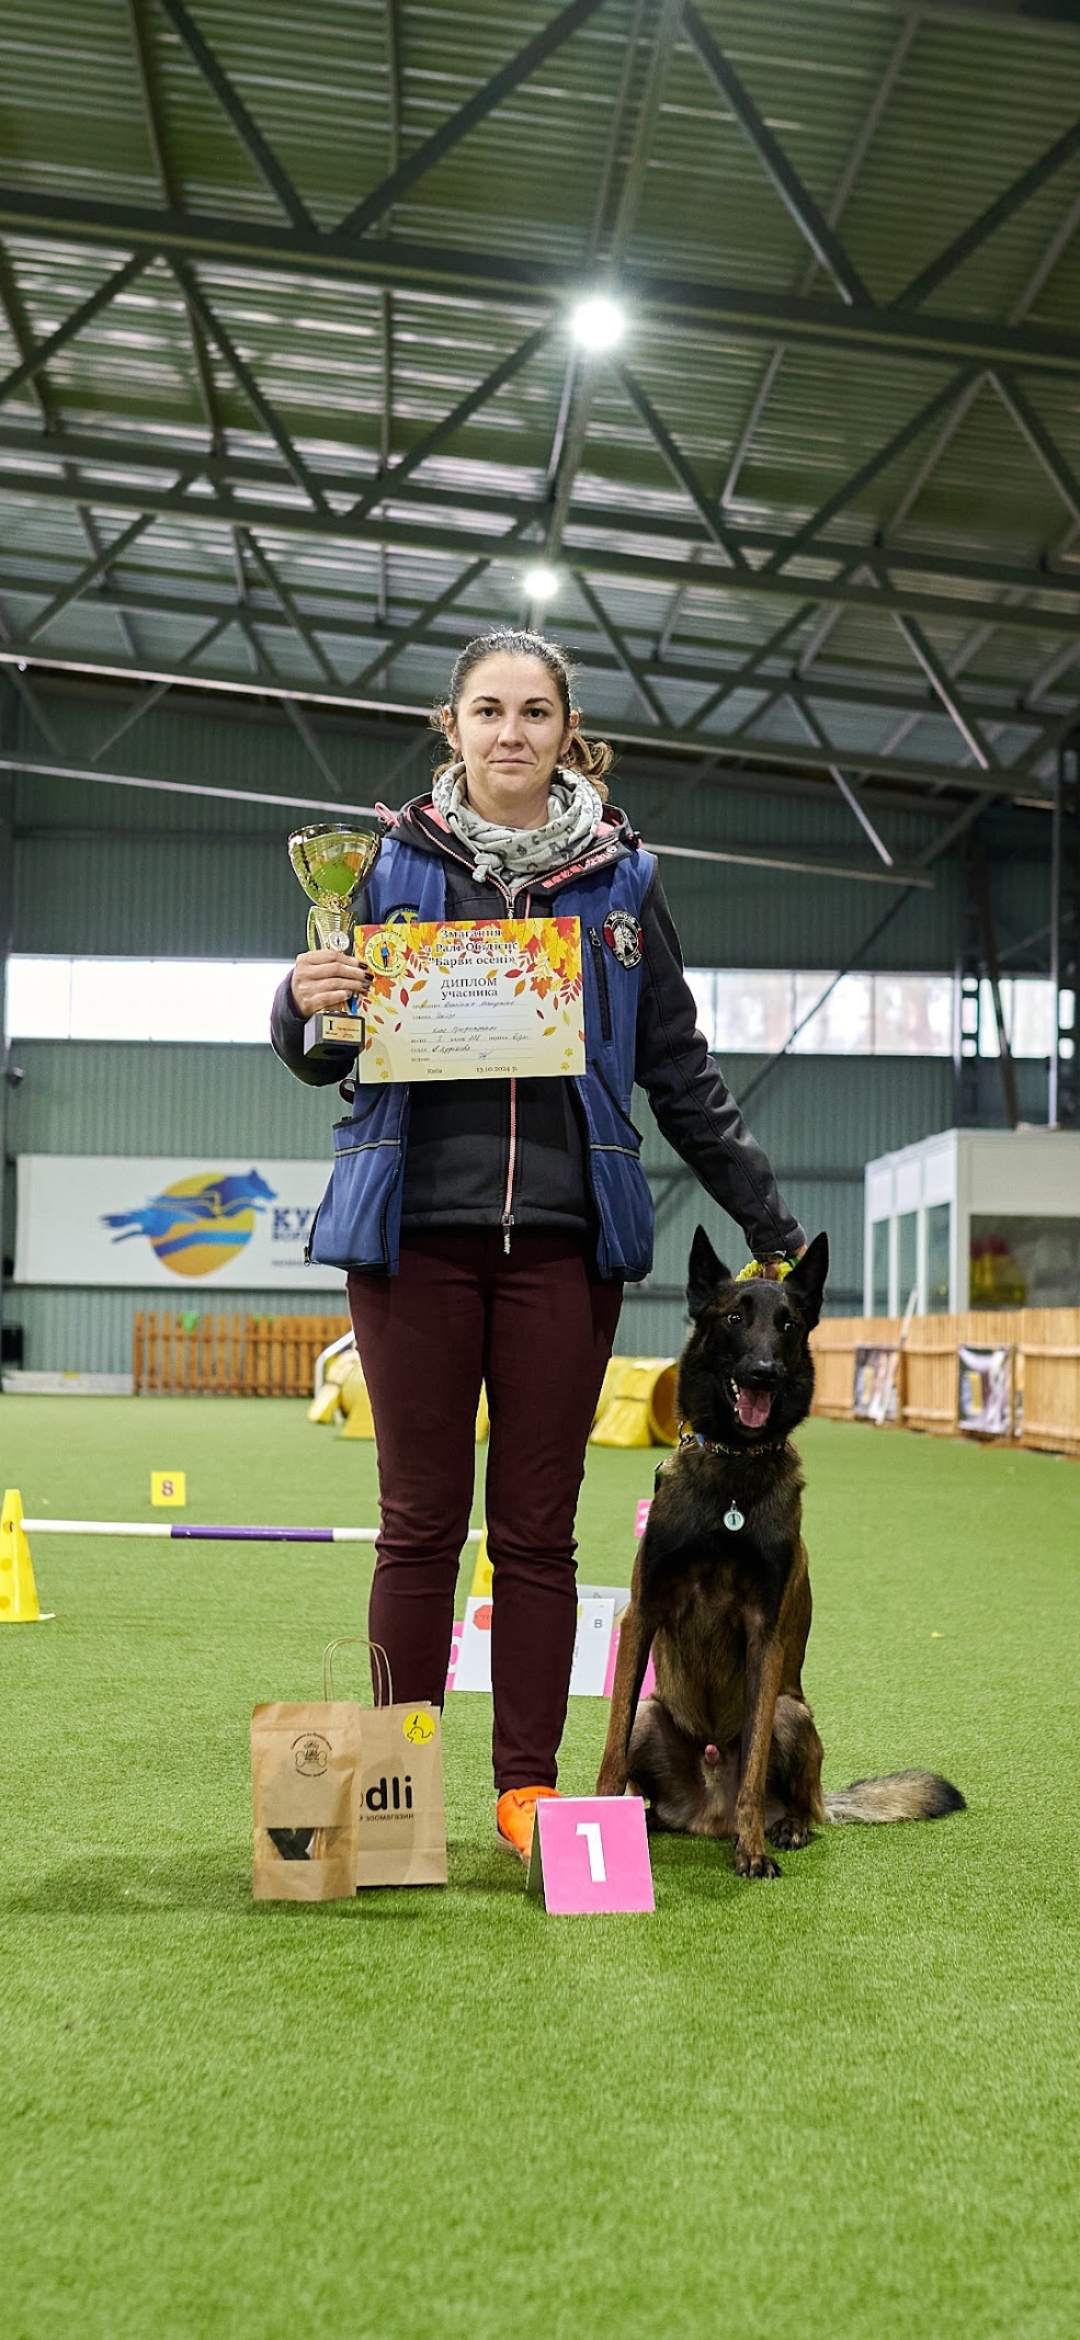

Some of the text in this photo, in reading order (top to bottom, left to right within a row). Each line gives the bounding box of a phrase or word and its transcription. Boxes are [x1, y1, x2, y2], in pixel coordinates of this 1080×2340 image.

[441, 929, 501, 938] Змагання
[476, 955, 515, 965] осені»
[441, 978, 497, 989] ДИПЛОМ
[442, 989, 498, 1000] учасника
[162, 1480, 173, 1496] 8
[594, 1619, 603, 1628] B
[360, 1775, 413, 1811] dli
[576, 1823, 607, 1882] 1
